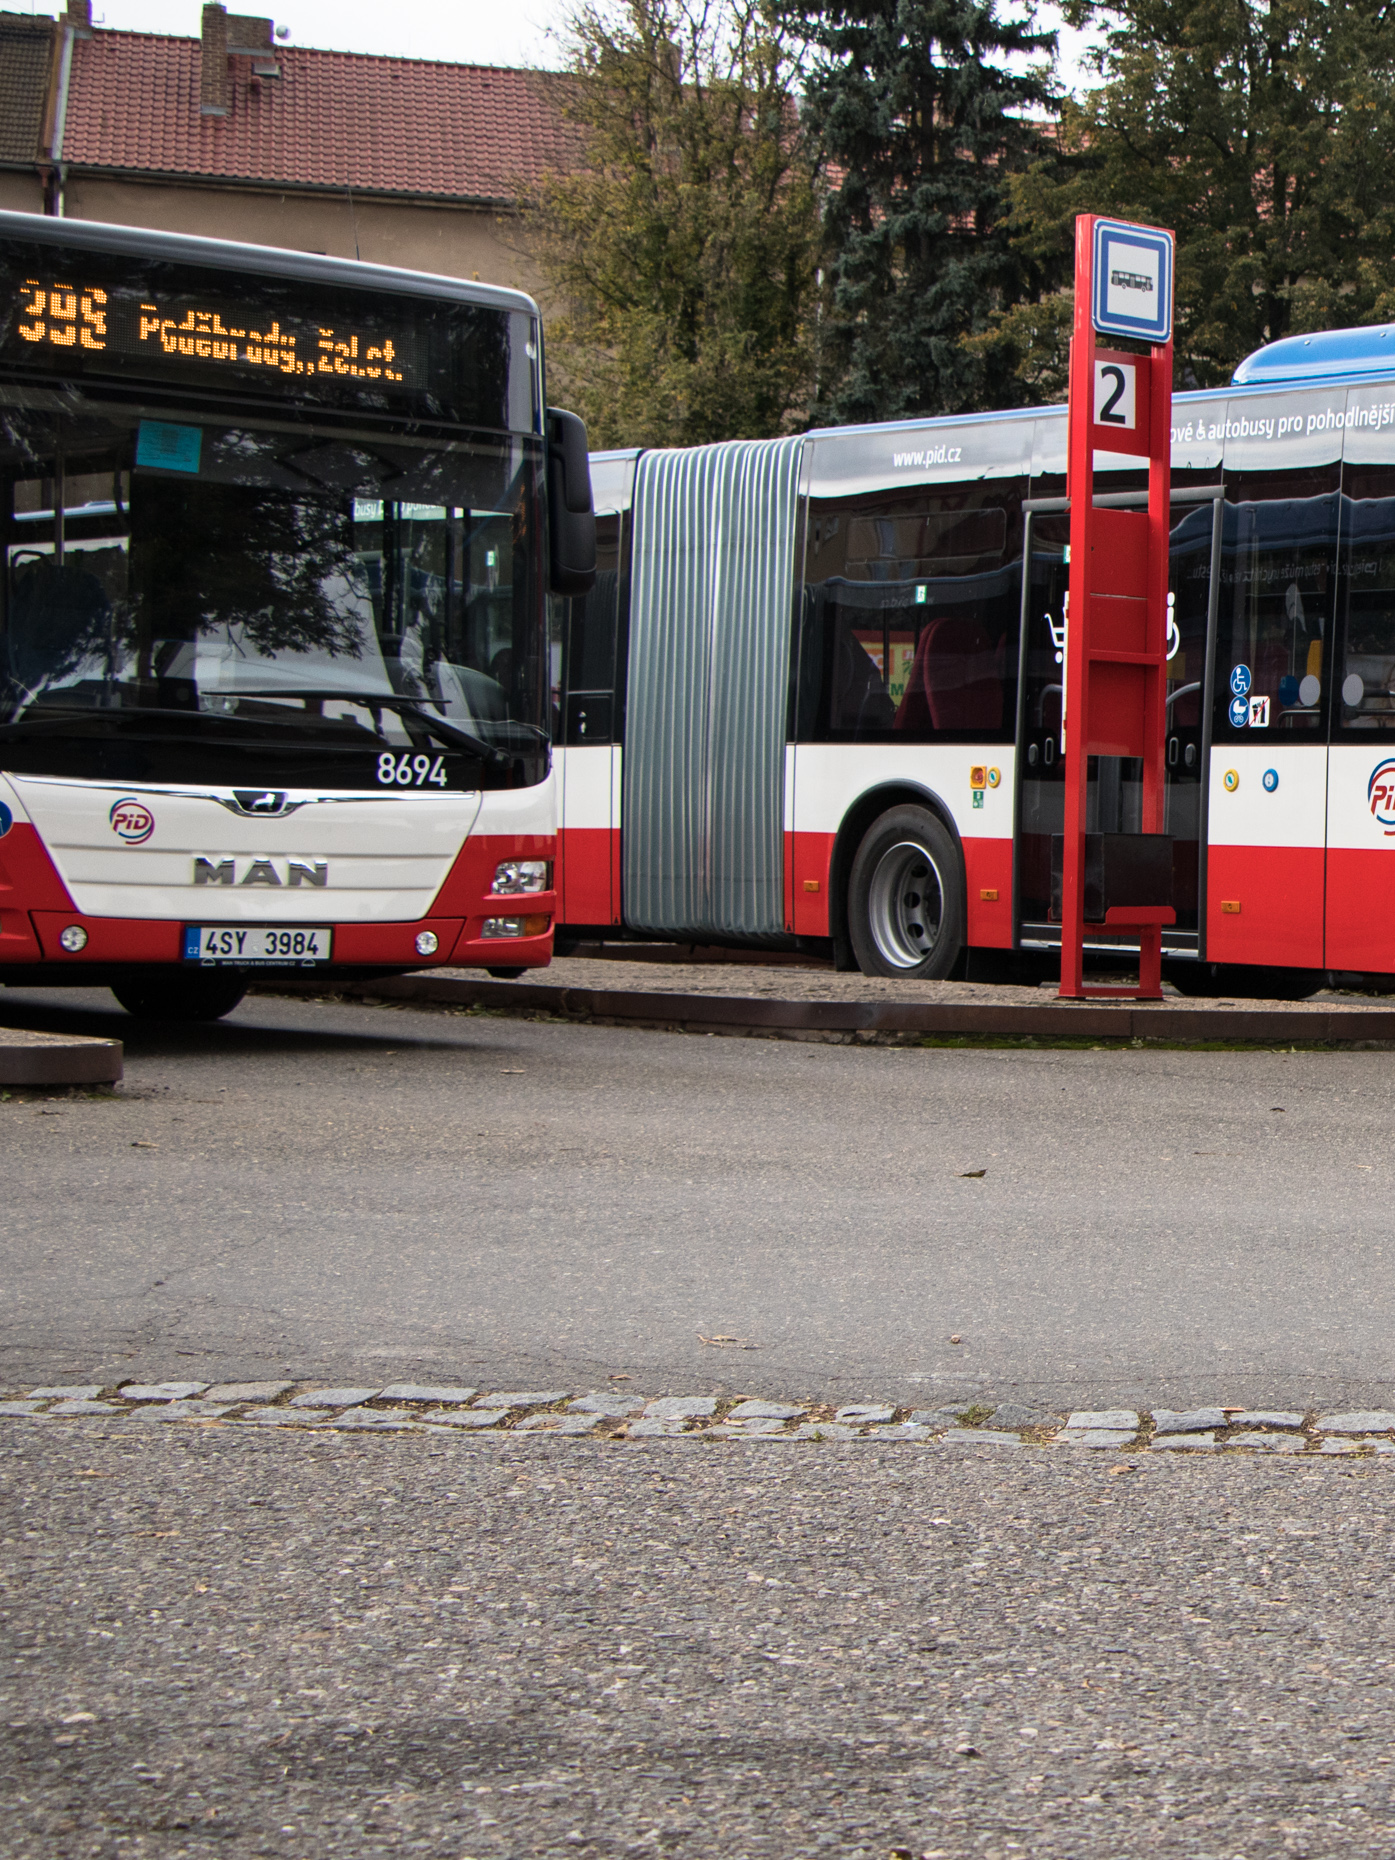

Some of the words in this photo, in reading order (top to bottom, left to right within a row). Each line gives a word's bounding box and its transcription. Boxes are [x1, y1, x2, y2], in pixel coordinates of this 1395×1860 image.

[1100, 365, 1126, 425] 2
[1208, 413, 1275, 440] autobusy
[1278, 415, 1302, 437] pro
[1306, 403, 1394, 435] pohodlnější
[893, 444, 962, 469] www.pid.cz
[377, 752, 448, 787] 8694
[192, 853, 329, 886] MAN
[206, 931, 248, 955] 4SY
[265, 931, 319, 955] 3984
